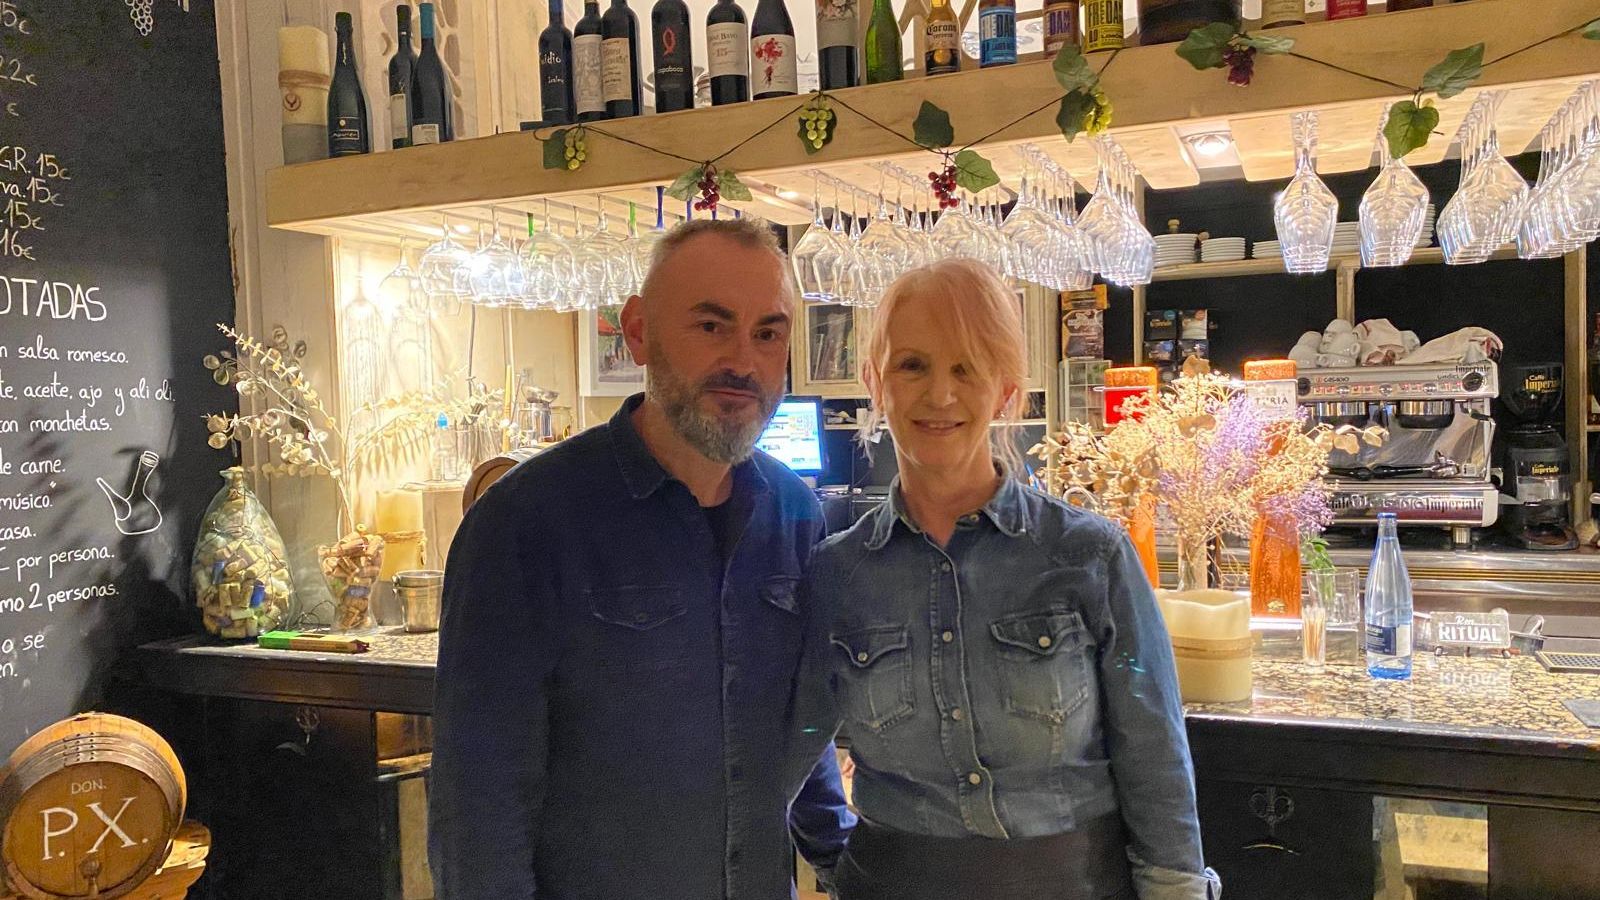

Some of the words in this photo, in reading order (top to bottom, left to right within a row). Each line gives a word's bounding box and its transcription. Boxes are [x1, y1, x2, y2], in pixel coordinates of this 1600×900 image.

[4, 199, 46, 231] 15€
[0, 228, 37, 261] 16€
[18, 334, 60, 361] salsa
[67, 350, 129, 364] romesco.
[78, 385, 103, 408] ajo
[114, 388, 126, 417] y
[129, 377, 150, 399] ali
[30, 408, 112, 433] monchetas.
[20, 459, 66, 475] carne.
[17, 556, 43, 582] por
[49, 546, 115, 579] persona.
[28, 582, 43, 609] 2
[47, 583, 119, 612] personas.
[1438, 623, 1502, 642] RITUAL
[1455, 615, 1474, 625] Ron
[22, 634, 45, 651] se
